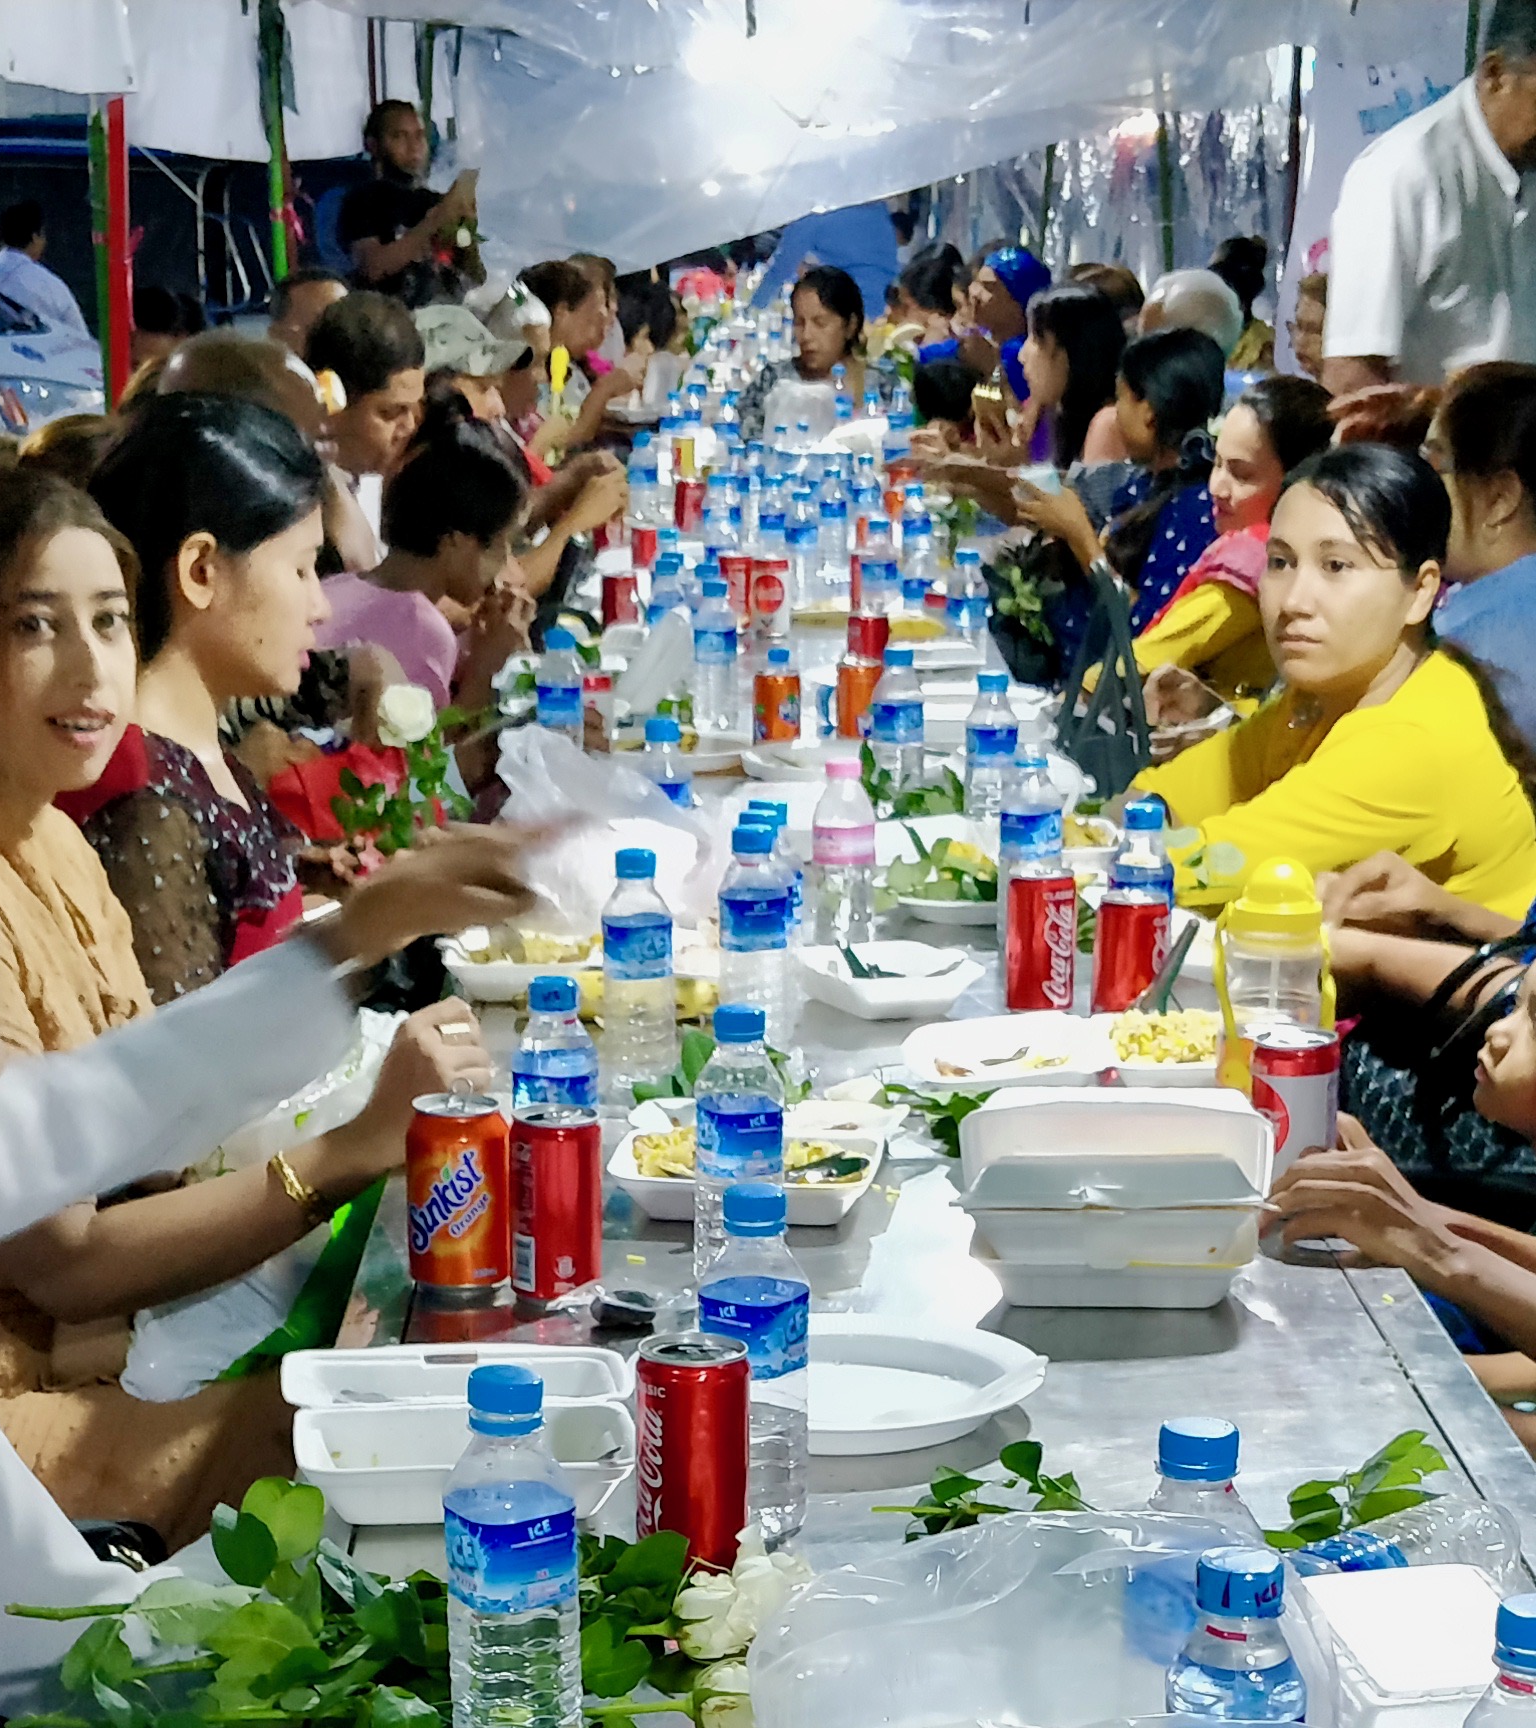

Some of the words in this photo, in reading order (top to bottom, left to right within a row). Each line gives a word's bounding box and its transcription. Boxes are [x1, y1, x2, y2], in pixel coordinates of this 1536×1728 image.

[408, 1150, 482, 1253] Sunkist
[449, 1192, 490, 1238] Orange
[718, 1305, 738, 1318] ICE
[527, 1519, 552, 1541] ICE
